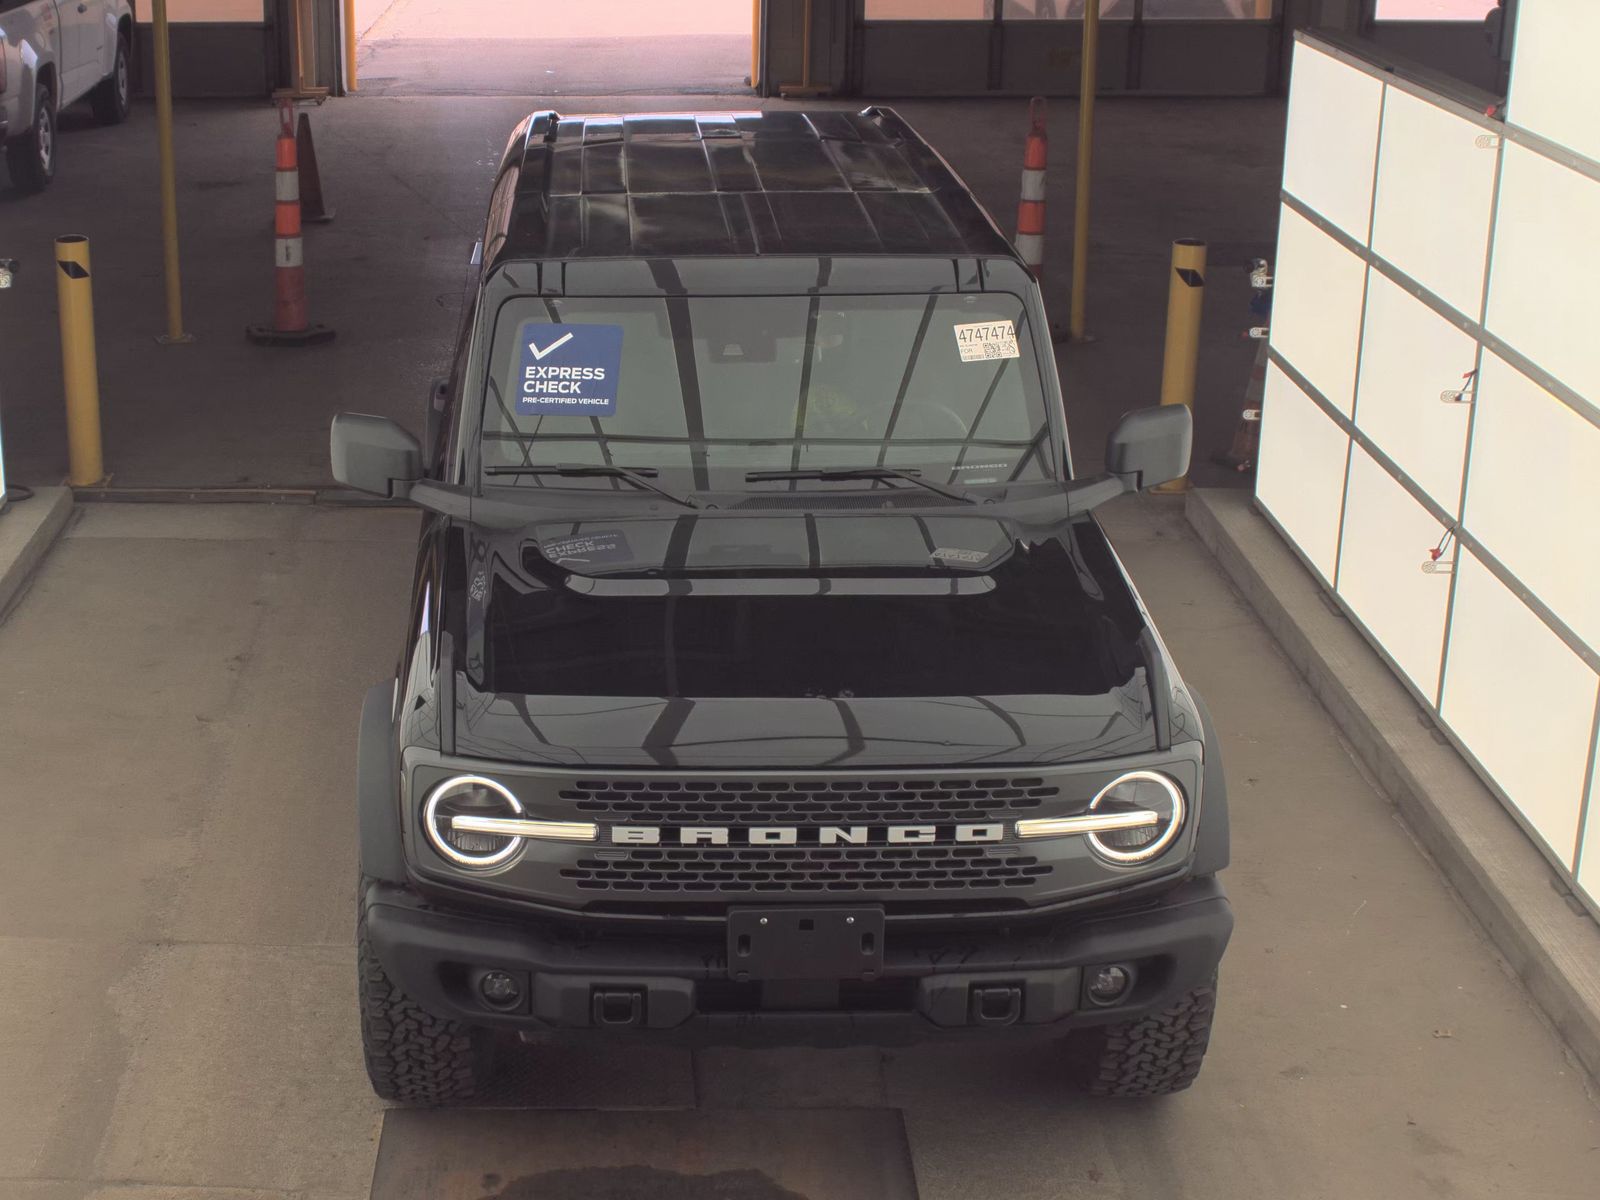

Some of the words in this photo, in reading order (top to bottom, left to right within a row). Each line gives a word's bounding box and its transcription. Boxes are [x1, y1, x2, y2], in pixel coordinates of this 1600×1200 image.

[958, 325, 1016, 342] 4747474
[525, 366, 606, 380] EXPRESS
[523, 380, 582, 394] CHECK
[522, 396, 577, 404] PRE-CERTIFIED
[611, 823, 1004, 844] BRONCO
